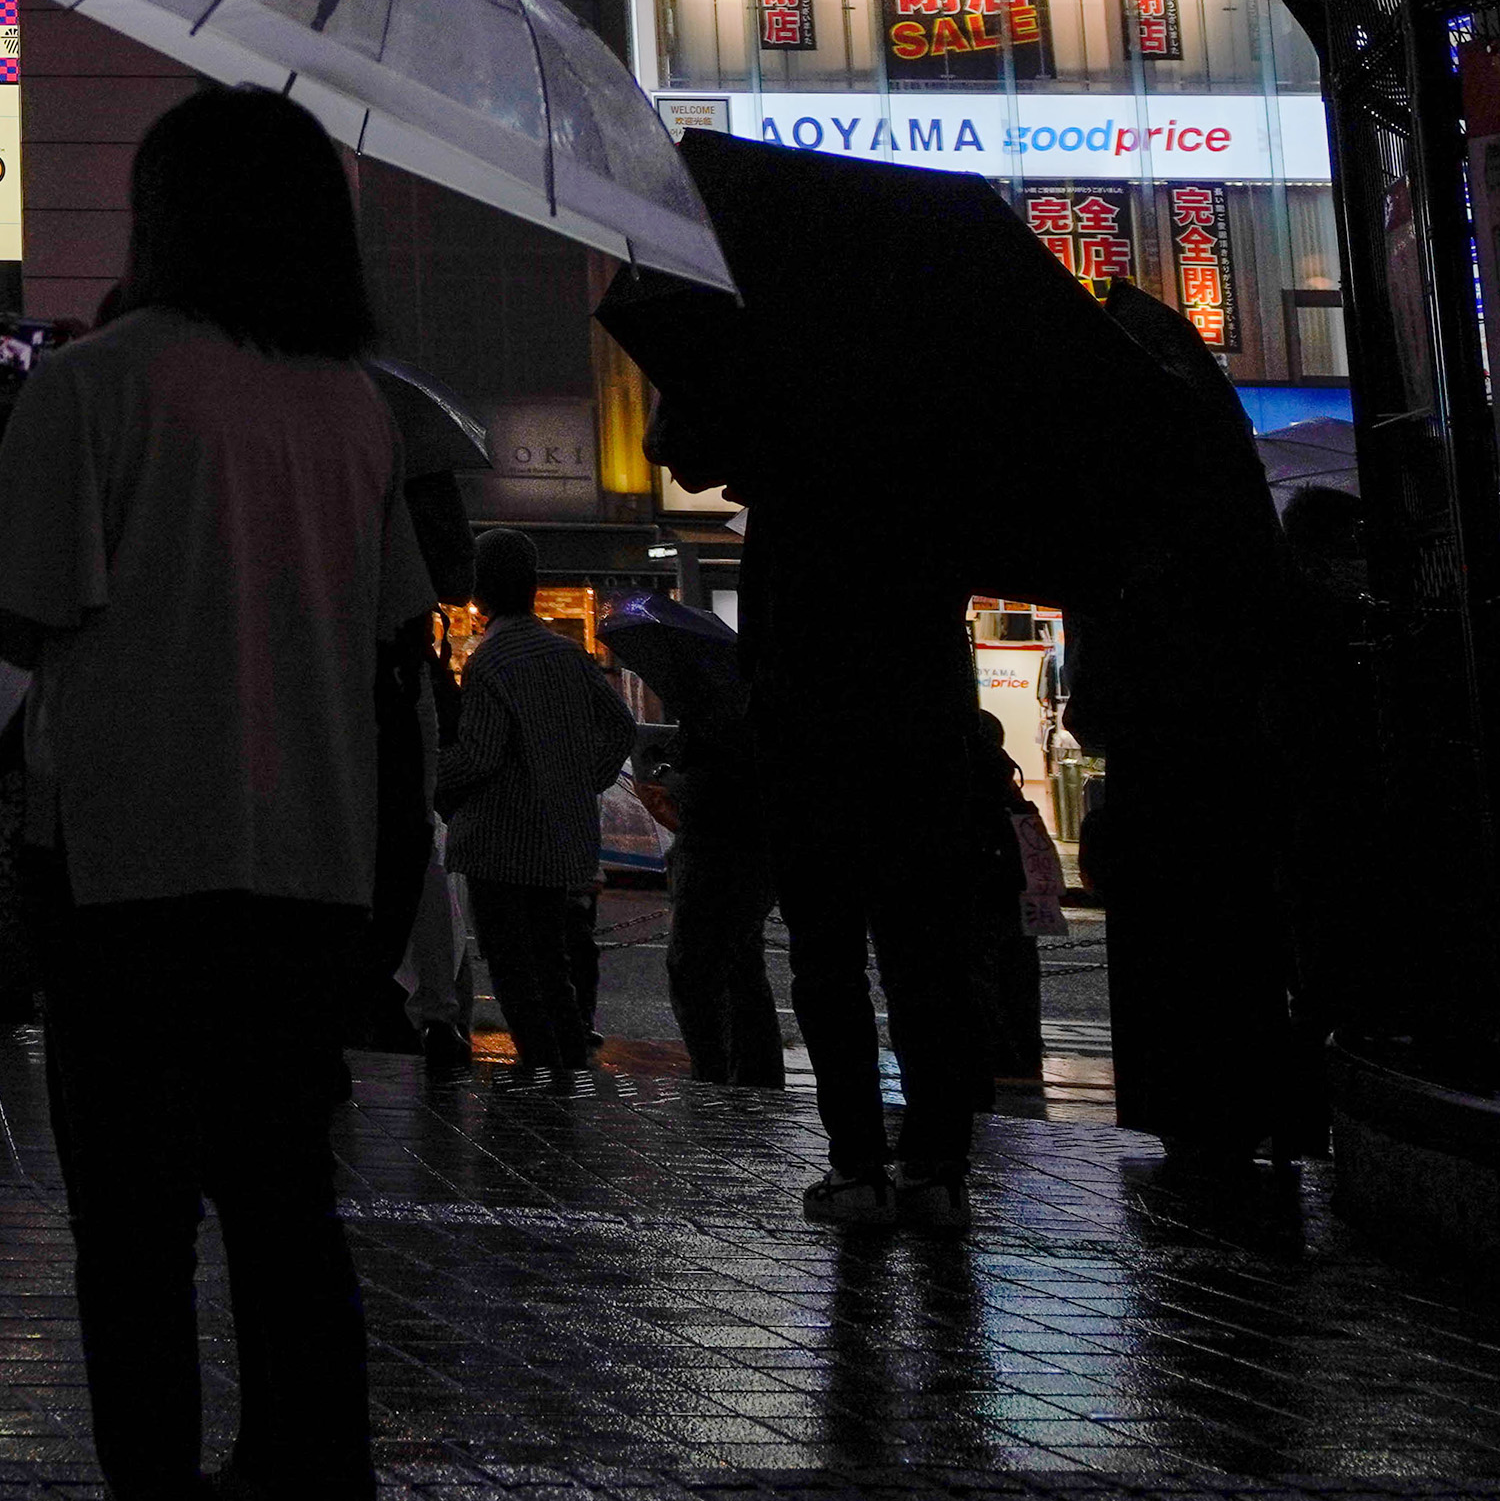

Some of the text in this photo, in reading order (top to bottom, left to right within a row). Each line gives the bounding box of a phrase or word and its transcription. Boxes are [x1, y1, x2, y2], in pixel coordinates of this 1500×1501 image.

[890, 4, 1042, 61] SALE
[670, 105, 716, 115] WELCOME
[760, 116, 986, 153] AOYAMA
[1026, 196, 1121, 234] 完全
[1173, 186, 1225, 346] 完全閉店
